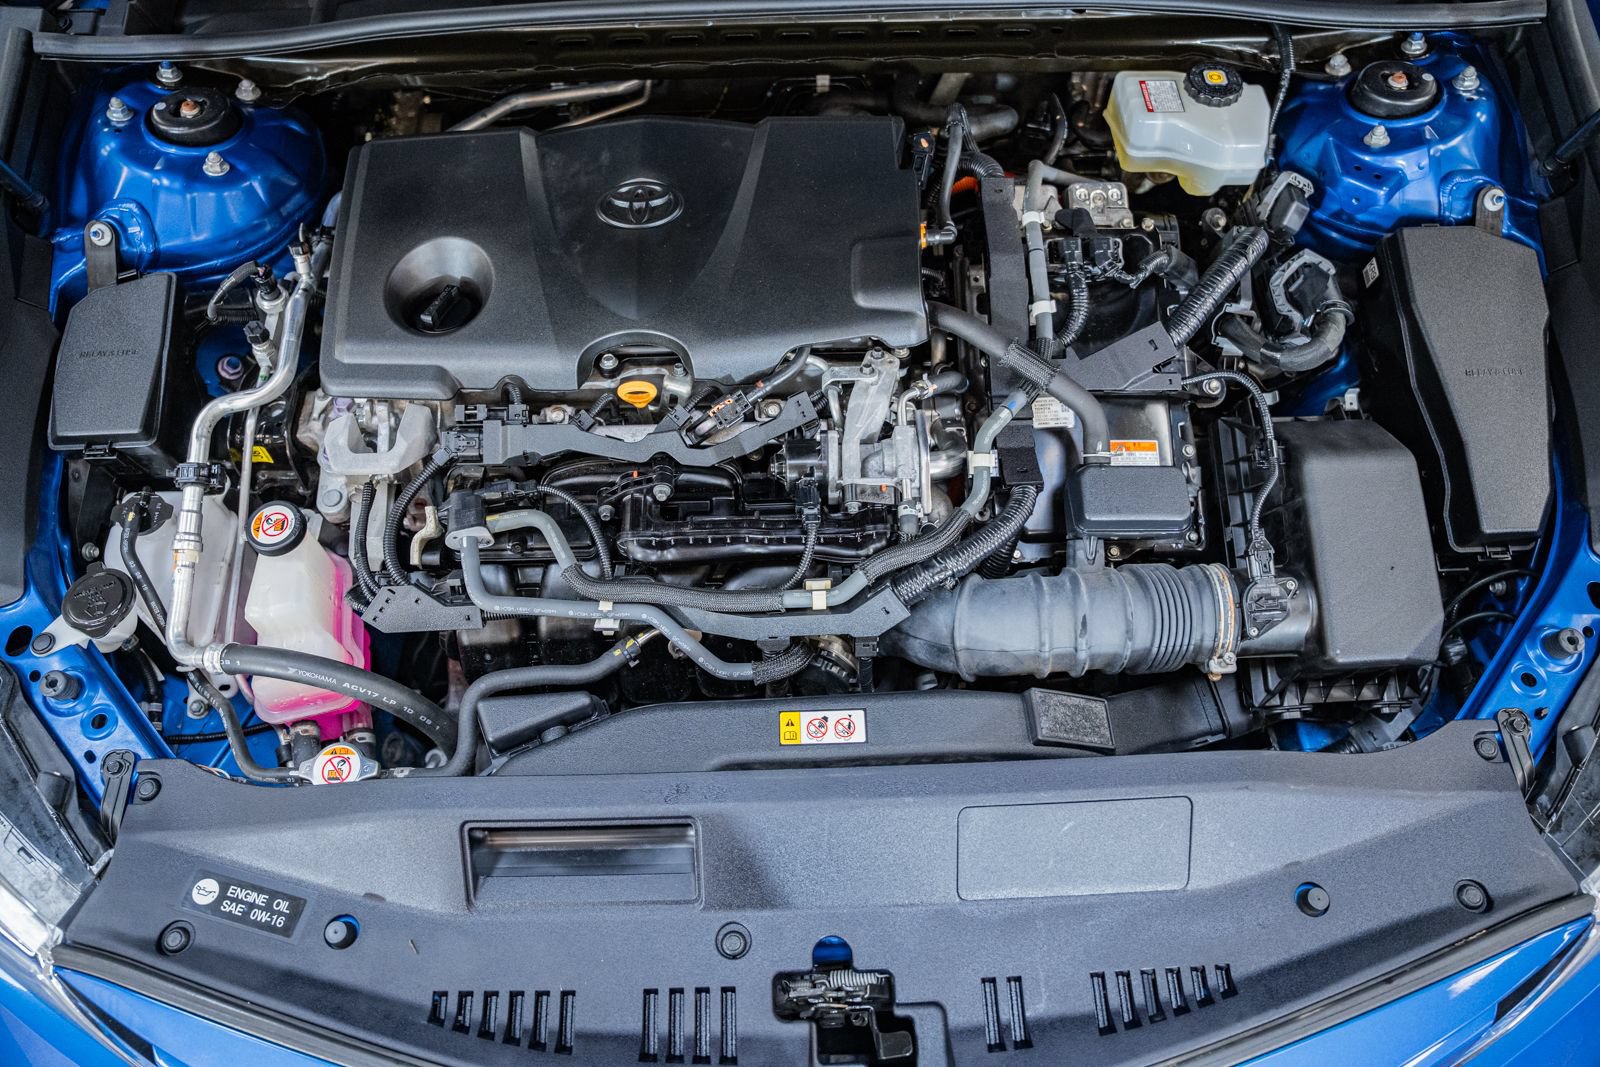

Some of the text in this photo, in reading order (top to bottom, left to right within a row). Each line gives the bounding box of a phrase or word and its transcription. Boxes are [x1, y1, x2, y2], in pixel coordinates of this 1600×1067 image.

[298, 670, 337, 685] YOKOHAMA
[342, 682, 380, 698] ACV17
[382, 696, 397, 705] LP
[220, 900, 286, 928] SAE 0W-16
[226, 885, 290, 914] ENGINE OIL
